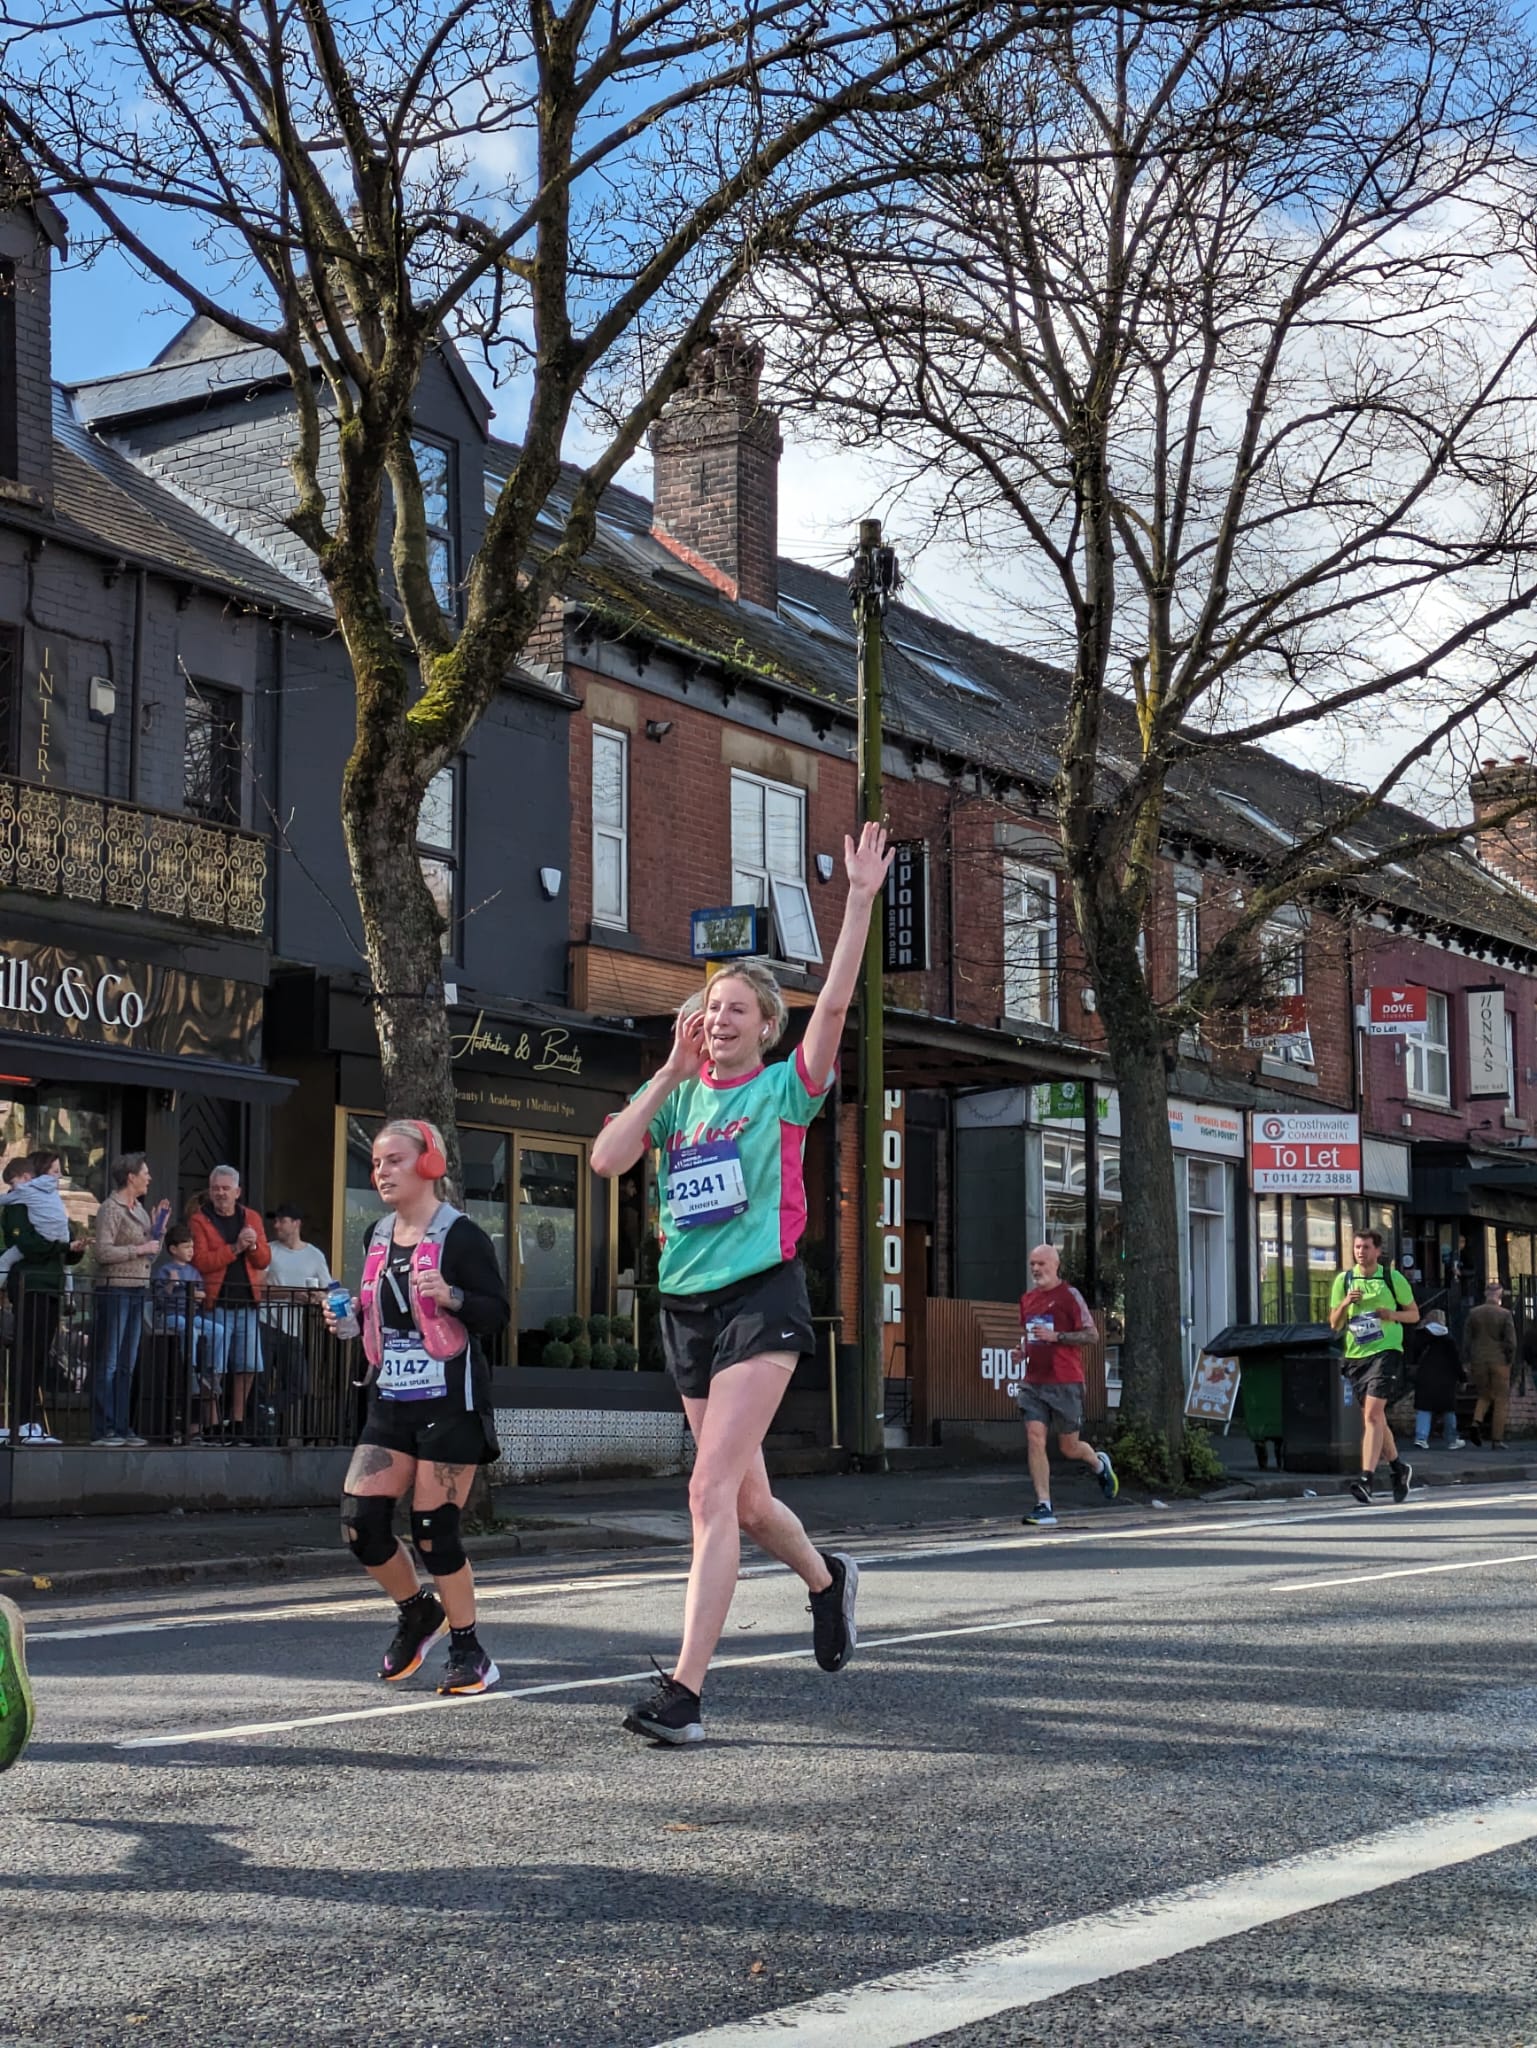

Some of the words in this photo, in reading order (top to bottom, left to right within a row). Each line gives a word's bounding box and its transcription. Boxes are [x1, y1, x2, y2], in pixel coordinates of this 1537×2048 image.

[38, 647, 53, 784] INTER
[54, 966, 90, 1020] &
[96, 974, 144, 1028] Co
[1382, 1003, 1414, 1014] DOVE
[1372, 1025, 1382, 1033] To
[1384, 1024, 1397, 1033] Let
[450, 1010, 511, 1059] Aesthetics
[514, 1033, 531, 1061] &
[533, 1027, 583, 1075] Beauty
[488, 1092, 522, 1111] Academy
[531, 1098, 560, 1114] Medical
[561, 1102, 576, 1118] Spa
[1287, 1119, 1350, 1130] Crosthwaite
[1287, 1132, 1348, 1140] COMMERCIAL
[1270, 1144, 1297, 1168] To
[1305, 1144, 1341, 1168] Let
[1263, 1173, 1269, 1183] T
[1272, 1173, 1298, 1183] 0114
[1302, 1173, 1322, 1184] 272
[1325, 1173, 1352, 1184] 3888
[385, 1360, 430, 1376] 3147
